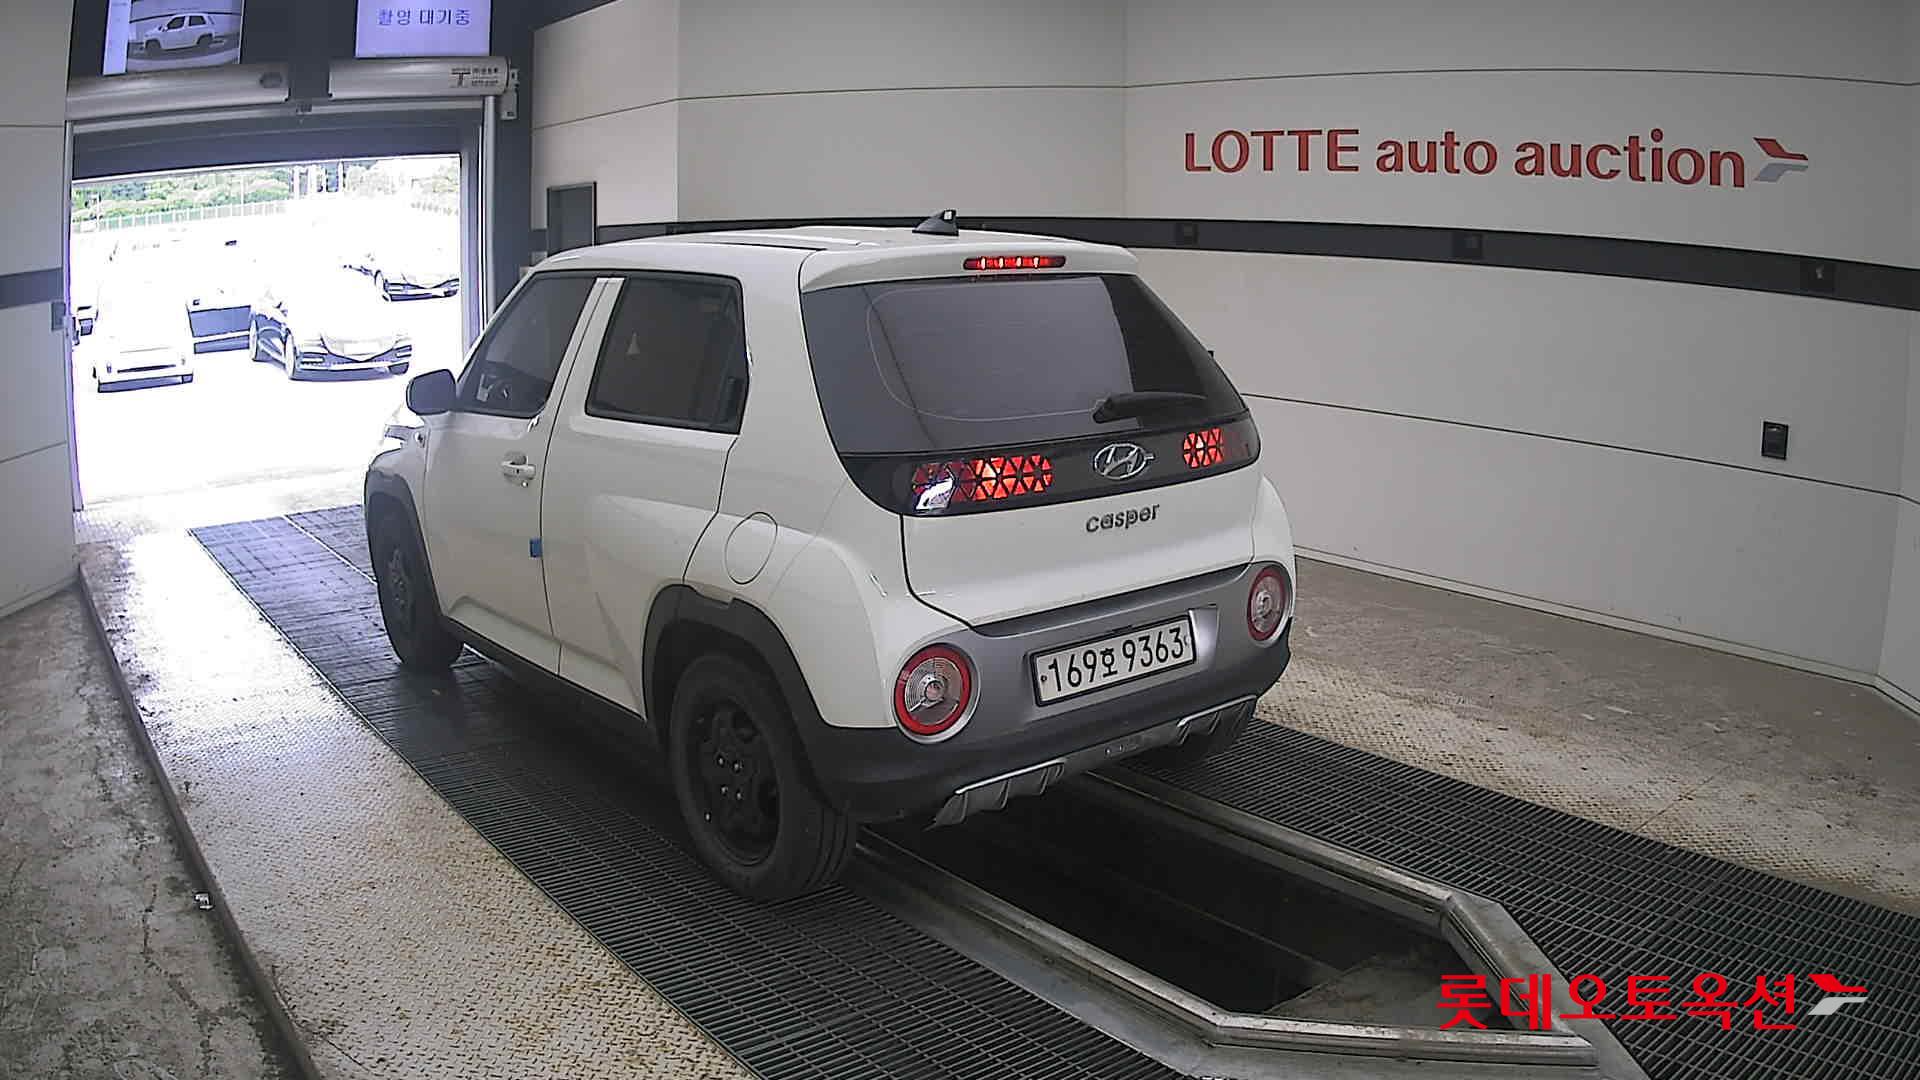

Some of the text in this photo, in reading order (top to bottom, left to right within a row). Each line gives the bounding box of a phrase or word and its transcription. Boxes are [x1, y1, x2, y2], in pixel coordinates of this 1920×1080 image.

[419, 8, 471, 26] 대기중
[1185, 129, 1746, 188] LOTTE auto auction
[1085, 503, 1160, 533] casper
[1048, 627, 1184, 692] 169호 9363
